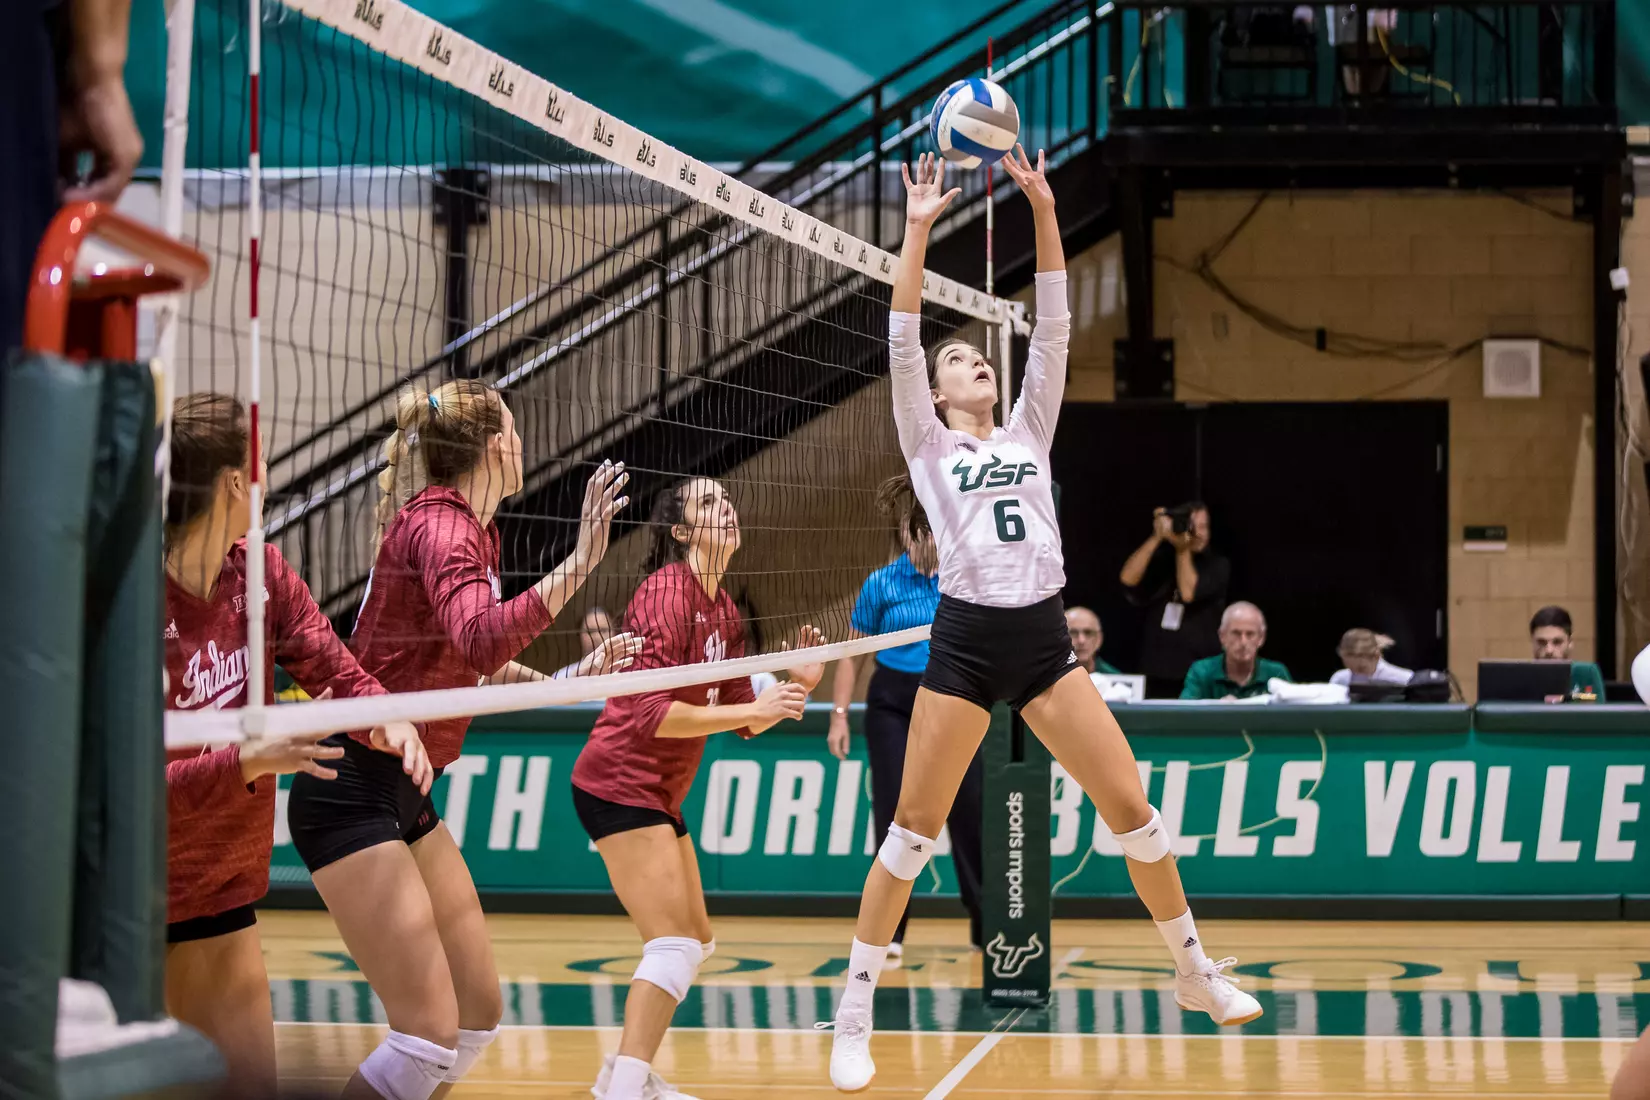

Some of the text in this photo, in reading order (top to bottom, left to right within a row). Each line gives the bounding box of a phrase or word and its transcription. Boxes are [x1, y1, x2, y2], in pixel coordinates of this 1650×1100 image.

[951, 453, 1038, 493] USF
[993, 499, 1027, 543] 6
[1363, 760, 1646, 863] VOLLE
[1005, 791, 1024, 919] sports imports
